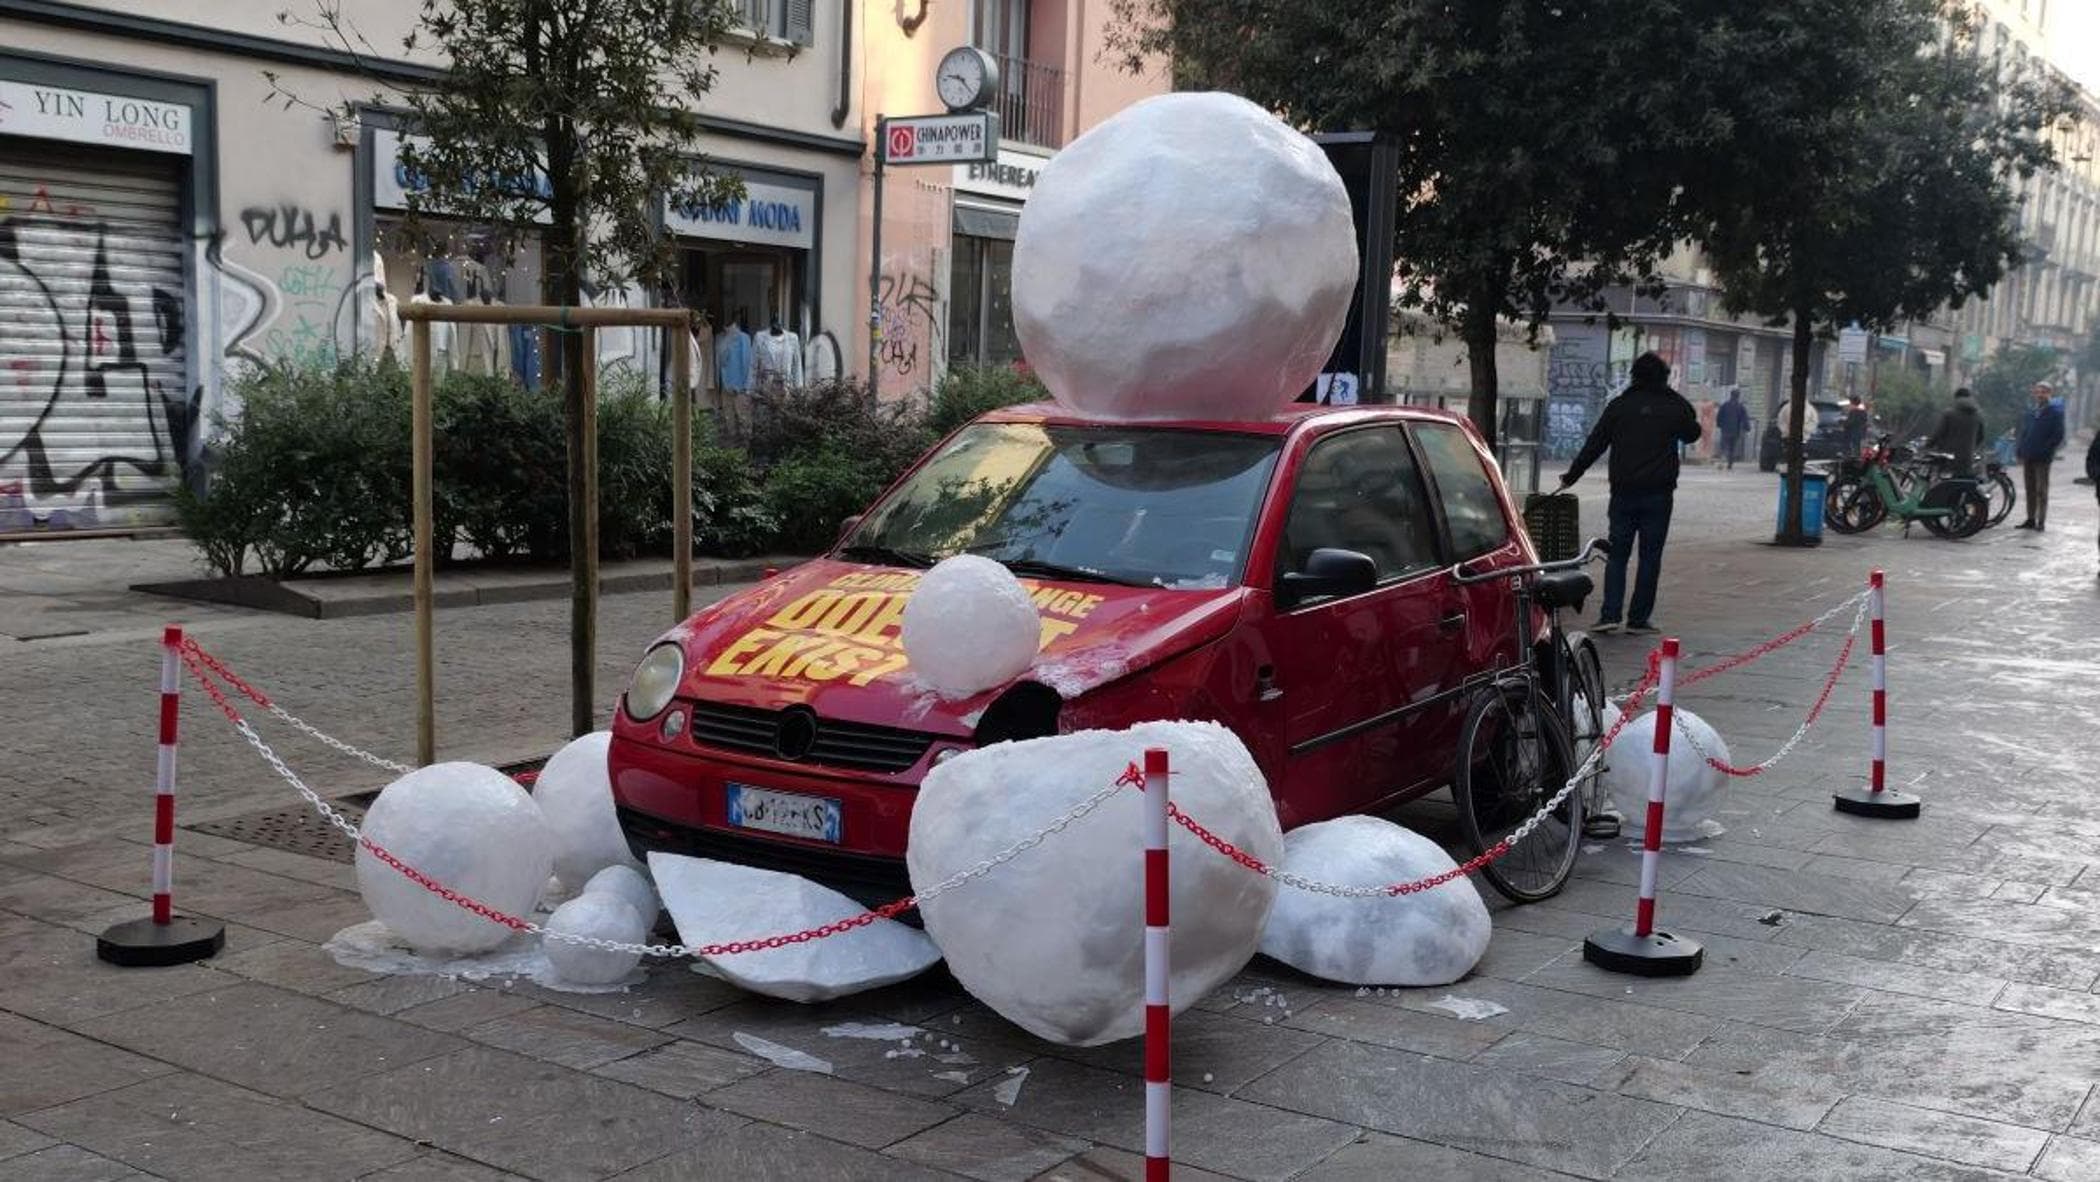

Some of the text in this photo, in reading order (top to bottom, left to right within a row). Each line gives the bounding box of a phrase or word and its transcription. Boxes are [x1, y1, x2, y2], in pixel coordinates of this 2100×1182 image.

[35, 90, 84, 118] YIN
[104, 100, 180, 131] LONG
[102, 124, 185, 147] OMBRELLO
[916, 123, 982, 143] CHINAPOWER
[748, 199, 802, 233] MODA
[764, 589, 910, 650] DOE
